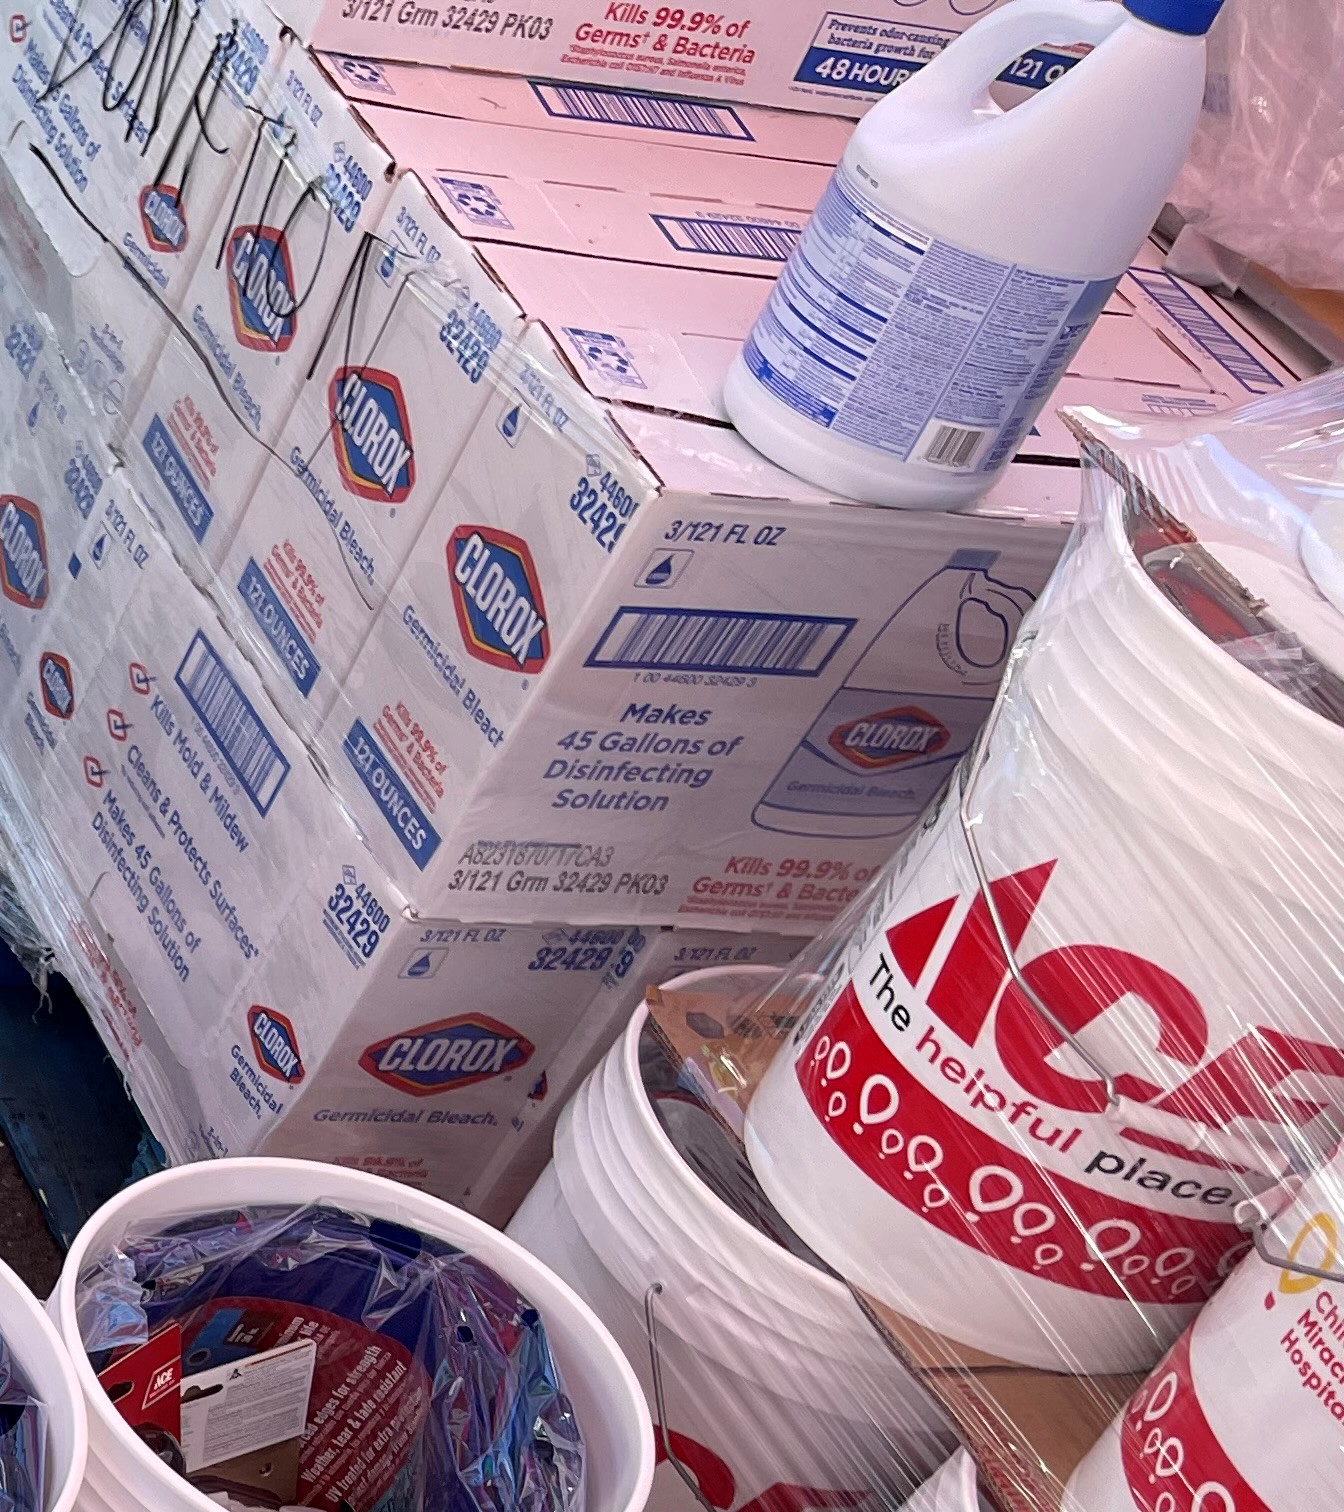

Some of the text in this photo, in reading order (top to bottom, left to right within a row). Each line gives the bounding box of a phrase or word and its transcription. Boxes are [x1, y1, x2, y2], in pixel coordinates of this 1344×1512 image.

[341, 2, 554, 41] 3/121 Grm 32429 PK03
[606, 2, 750, 39] Kills 99.9% of
[827, 19, 877, 37] Prevents
[653, 32, 668, 50] &
[672, 36, 756, 65] Bacteria
[815, 56, 851, 81] 48
[827, 33, 916, 59] bacteria growth
[232, 229, 298, 350] CLOROX
[439, 308, 490, 385] 32429
[334, 368, 414, 498] CLOROX
[0, 499, 49, 599] CLOROX
[665, 520, 787, 547] 3/121 FL OZ
[453, 531, 546, 667] CLOROX
[262, 601, 311, 682] OUNCES
[401, 603, 464, 697] Germicidal
[619, 703, 712, 727] Makes
[844, 721, 943, 753] CLOROX
[555, 729, 744, 757] 45 Gallons of
[149, 693, 176, 737] Kills
[172, 729, 203, 777] Mold
[199, 772, 212, 794] &
[207, 785, 250, 854] Mildew
[542, 758, 713, 788] Disinfecting
[126, 744, 164, 806] Cleans
[158, 796, 172, 819] &
[167, 809, 213, 886] Protects
[371, 763, 427, 851] OUNCES
[550, 788, 670, 812] Solution
[101, 788, 137, 848] Makes
[133, 841, 152, 870] 45
[147, 865, 195, 934] Gallons
[184, 927, 202, 954] of
[448, 871, 670, 896] 3/121 Grm 32429 PK03
[724, 856, 774, 877] Kills
[775, 857, 851, 882] 99.9%
[776, 881, 791, 900] &
[90, 810, 149, 914] Disinfecting
[146, 905, 191, 984] Solution
[354, 882, 391, 933] 44600
[327, 882, 382, 959] 32429
[419, 927, 506, 943] 3/121 FL OZ
[528, 947, 604, 972] 32429
[251, 1012, 301, 1080] CLOROX
[378, 1037, 518, 1073] CLOROX
[868, 953, 1083, 1155] The helpful
[230, 1043, 285, 1115] Germicidal
[312, 1108, 425, 1126] Germicidal
[153, 1367, 175, 1390] ACE
[312, 1344, 383, 1430] edges for strength
[332, 1428, 353, 1454] tear
[372, 1359, 408, 1403] resistant
[337, 1425, 394, 1493] treated extra
